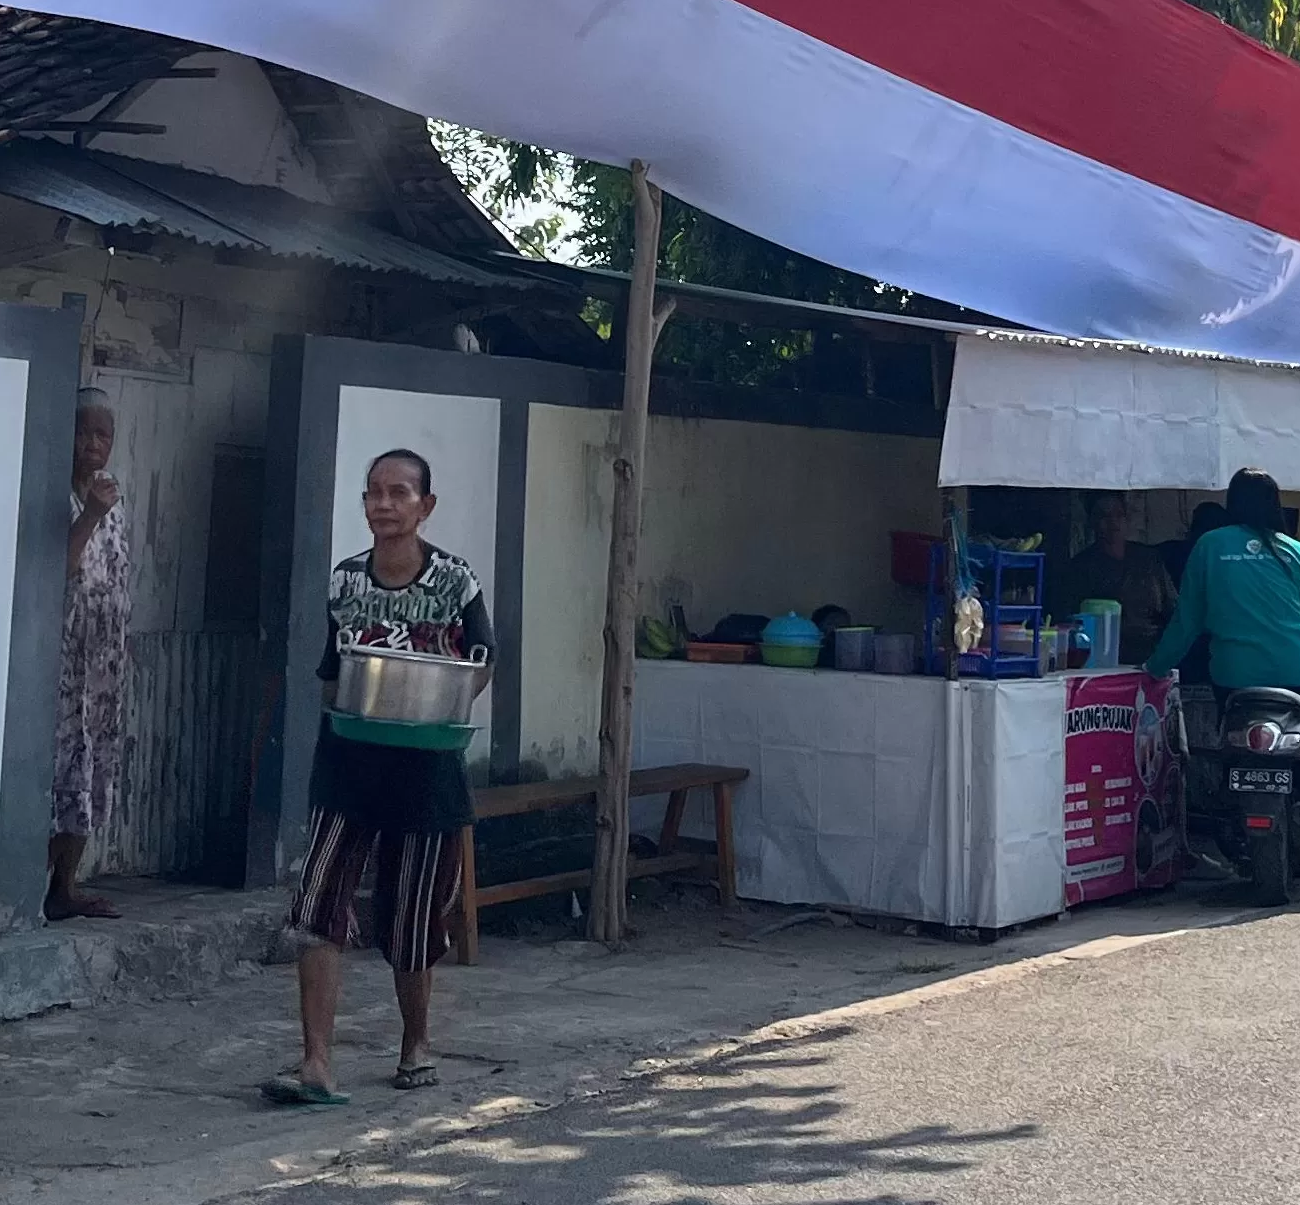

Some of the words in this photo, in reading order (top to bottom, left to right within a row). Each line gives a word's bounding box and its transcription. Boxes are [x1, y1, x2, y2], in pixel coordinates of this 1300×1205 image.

[1064, 706, 1101, 734] ARUNG
[1101, 706, 1134, 732] RUJAK
[1231, 770, 1240, 781] S
[1274, 771, 1290, 783] GS
